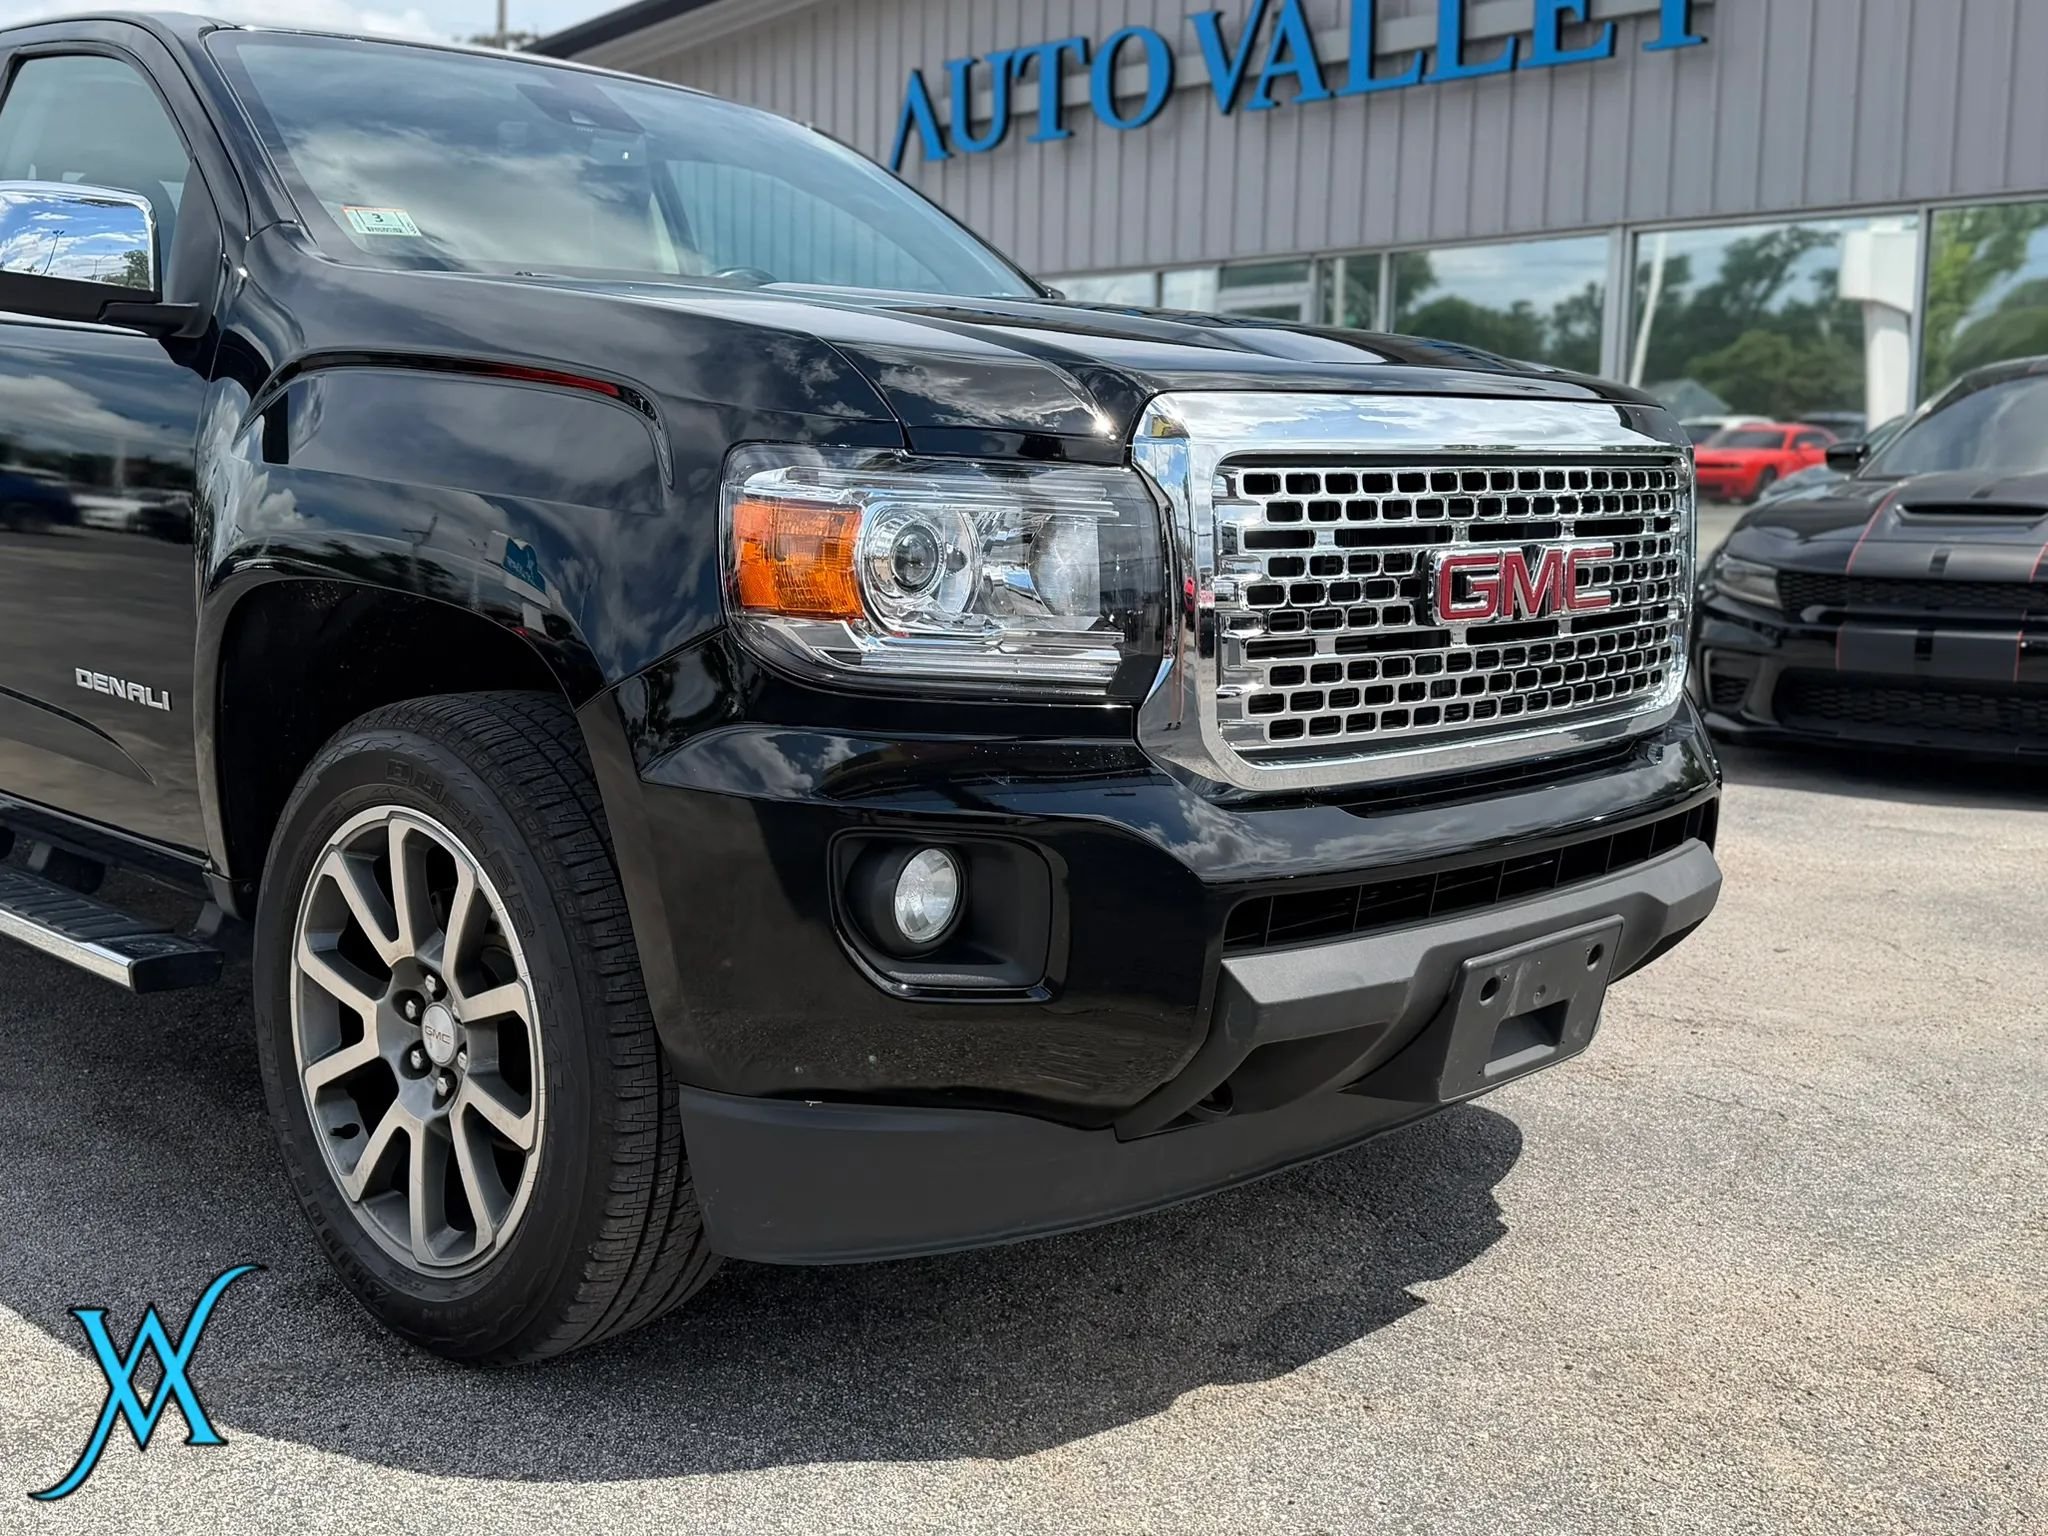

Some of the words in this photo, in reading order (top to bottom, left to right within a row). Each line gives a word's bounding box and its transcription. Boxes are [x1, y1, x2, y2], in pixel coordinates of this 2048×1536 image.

[890, 25, 1175, 171] AUTO
[1434, 544, 1614, 626] GMC
[75, 667, 171, 712] DENALI
[424, 1024, 451, 1045] GMC
